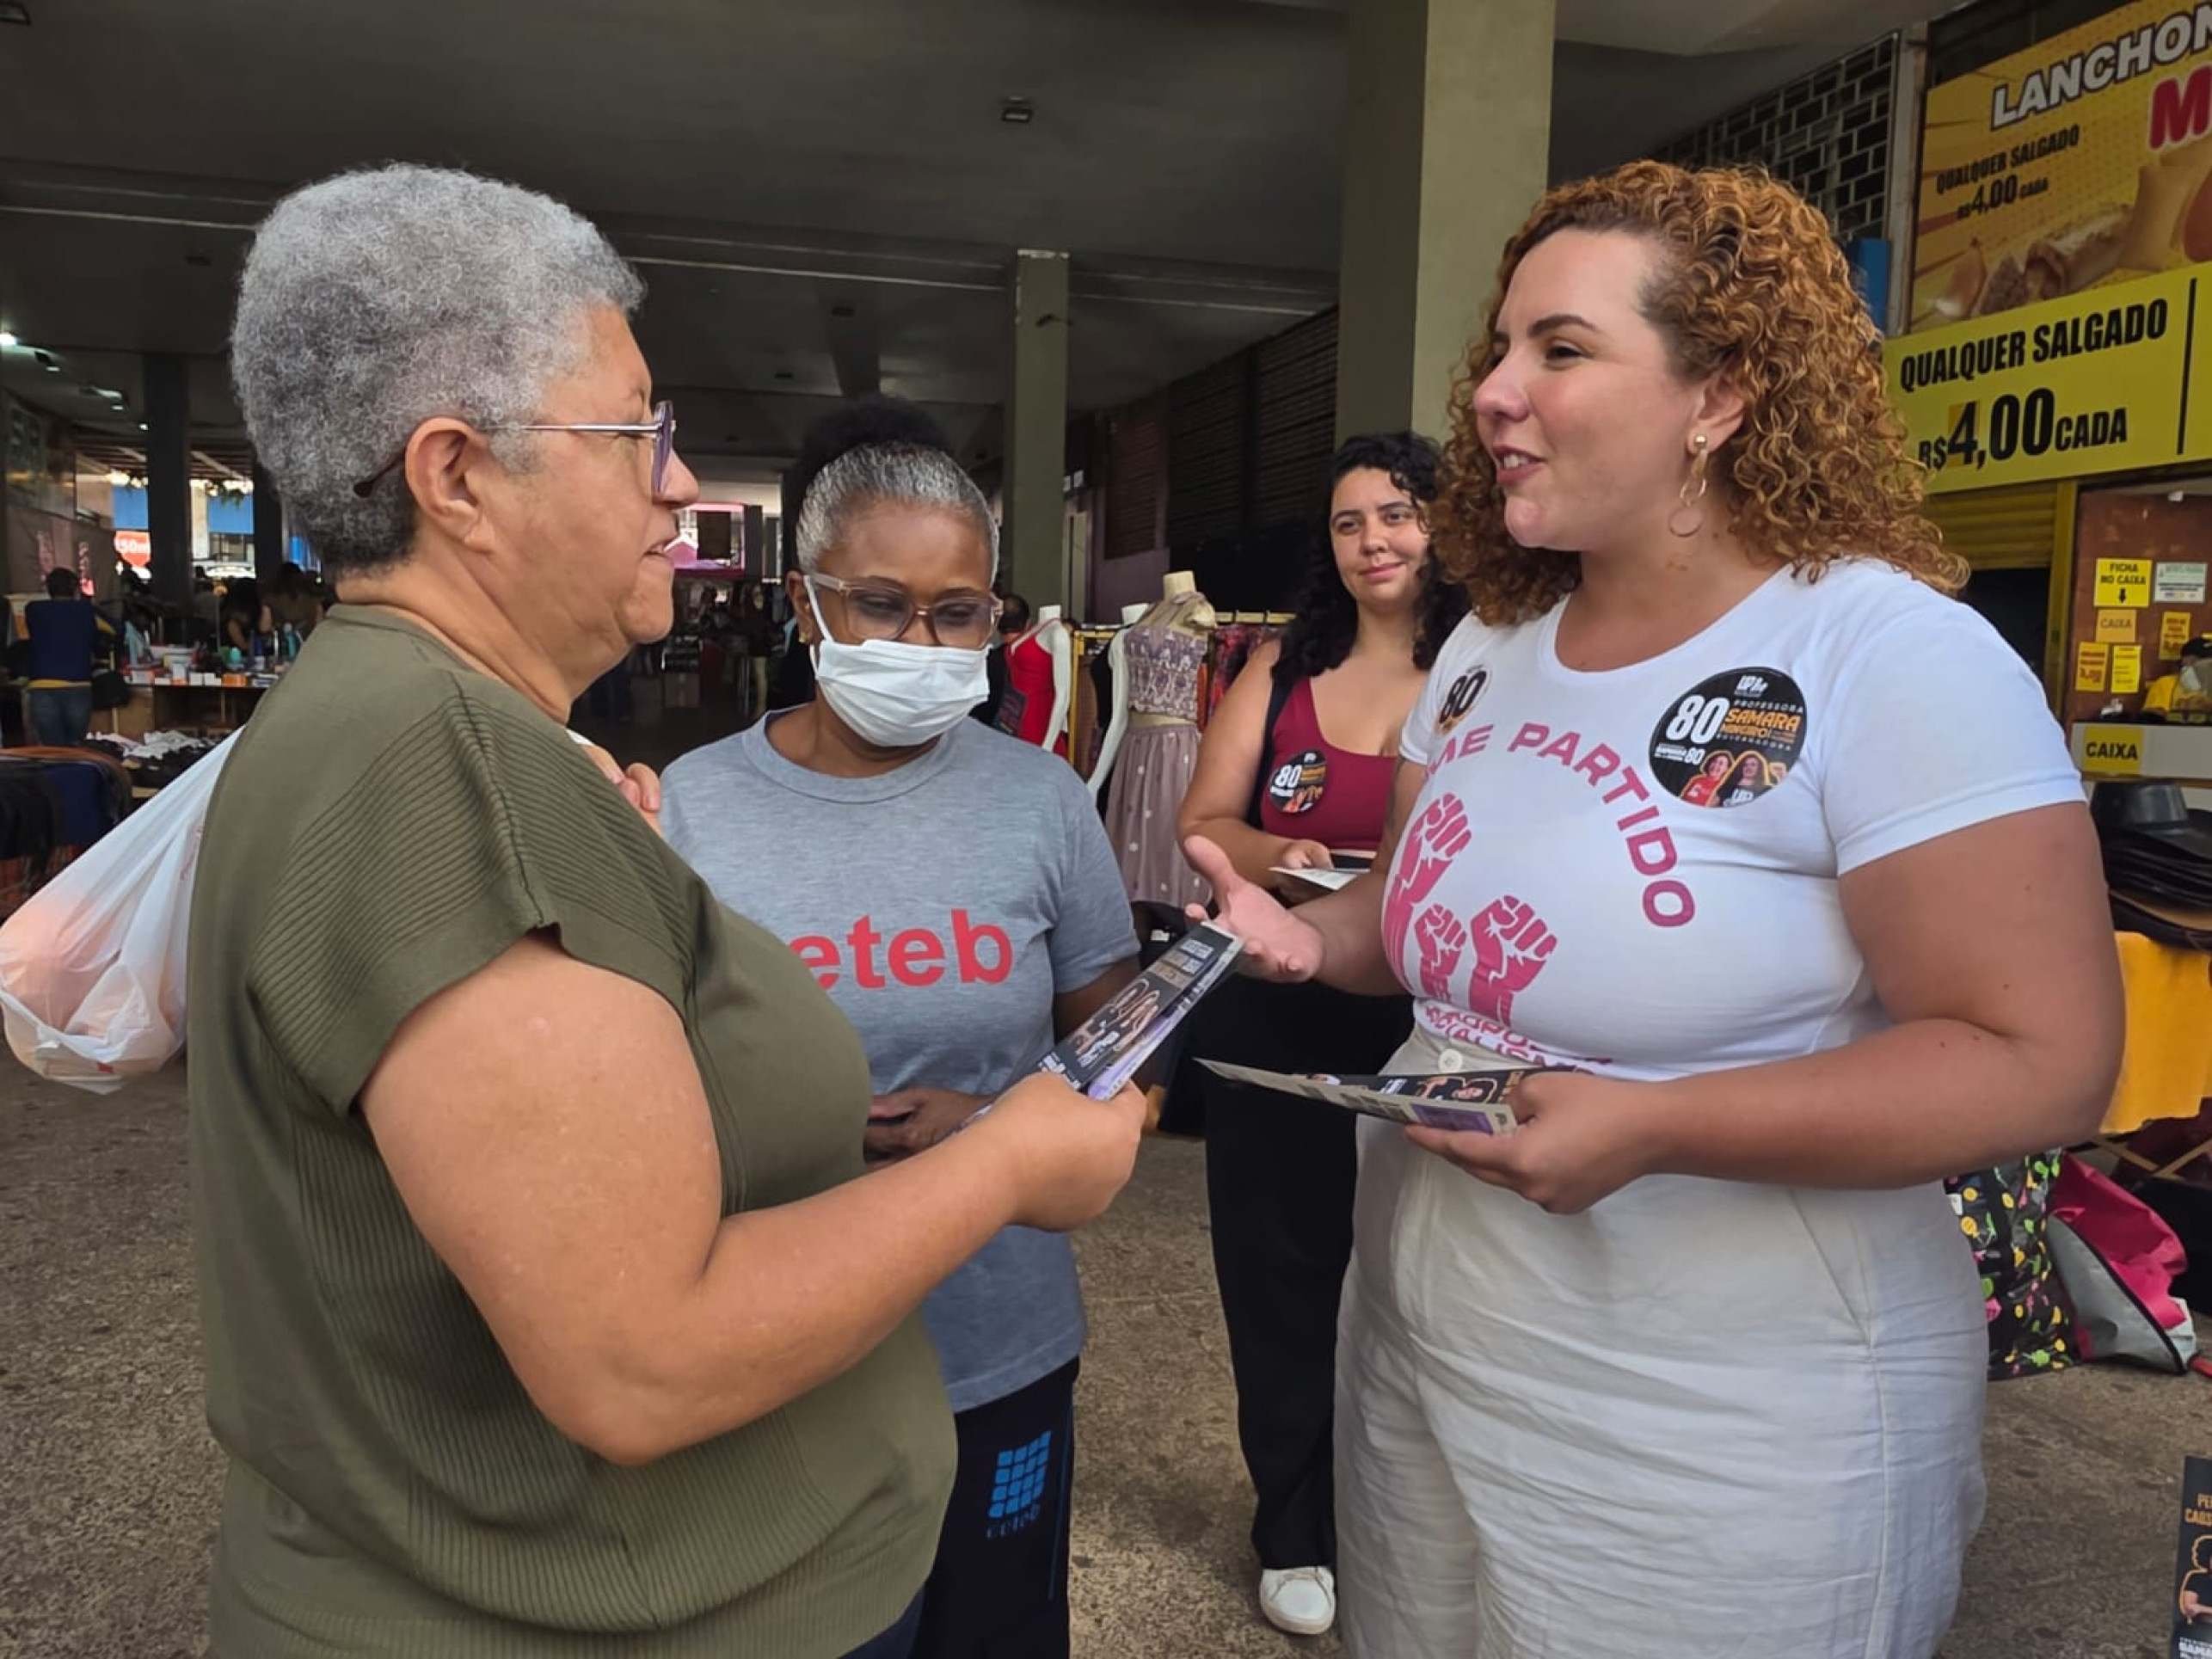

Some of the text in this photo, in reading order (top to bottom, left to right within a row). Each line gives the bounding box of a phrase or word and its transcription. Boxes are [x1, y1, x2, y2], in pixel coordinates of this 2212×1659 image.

[1937, 124, 2080, 194] QUALQUER SALGADO
[1901, 299, 2167, 392] QUALQUER SALGADO
[2055, 408, 2127, 452] CADA
[2109, 563, 2138, 572] FICHA
[2100, 575, 2147, 585] NO CAIXA
[2099, 618, 2132, 629] CAIXA
[1439, 671, 1486, 723] 80
[1666, 694, 1730, 744] 80
[1724, 708, 1801, 732] SAMARA
[1685, 747, 1705, 765] 80
[2086, 742, 2139, 760] CAIXA
[1275, 764, 1303, 788] 80
[1507, 722, 1695, 928] PARTIDO
